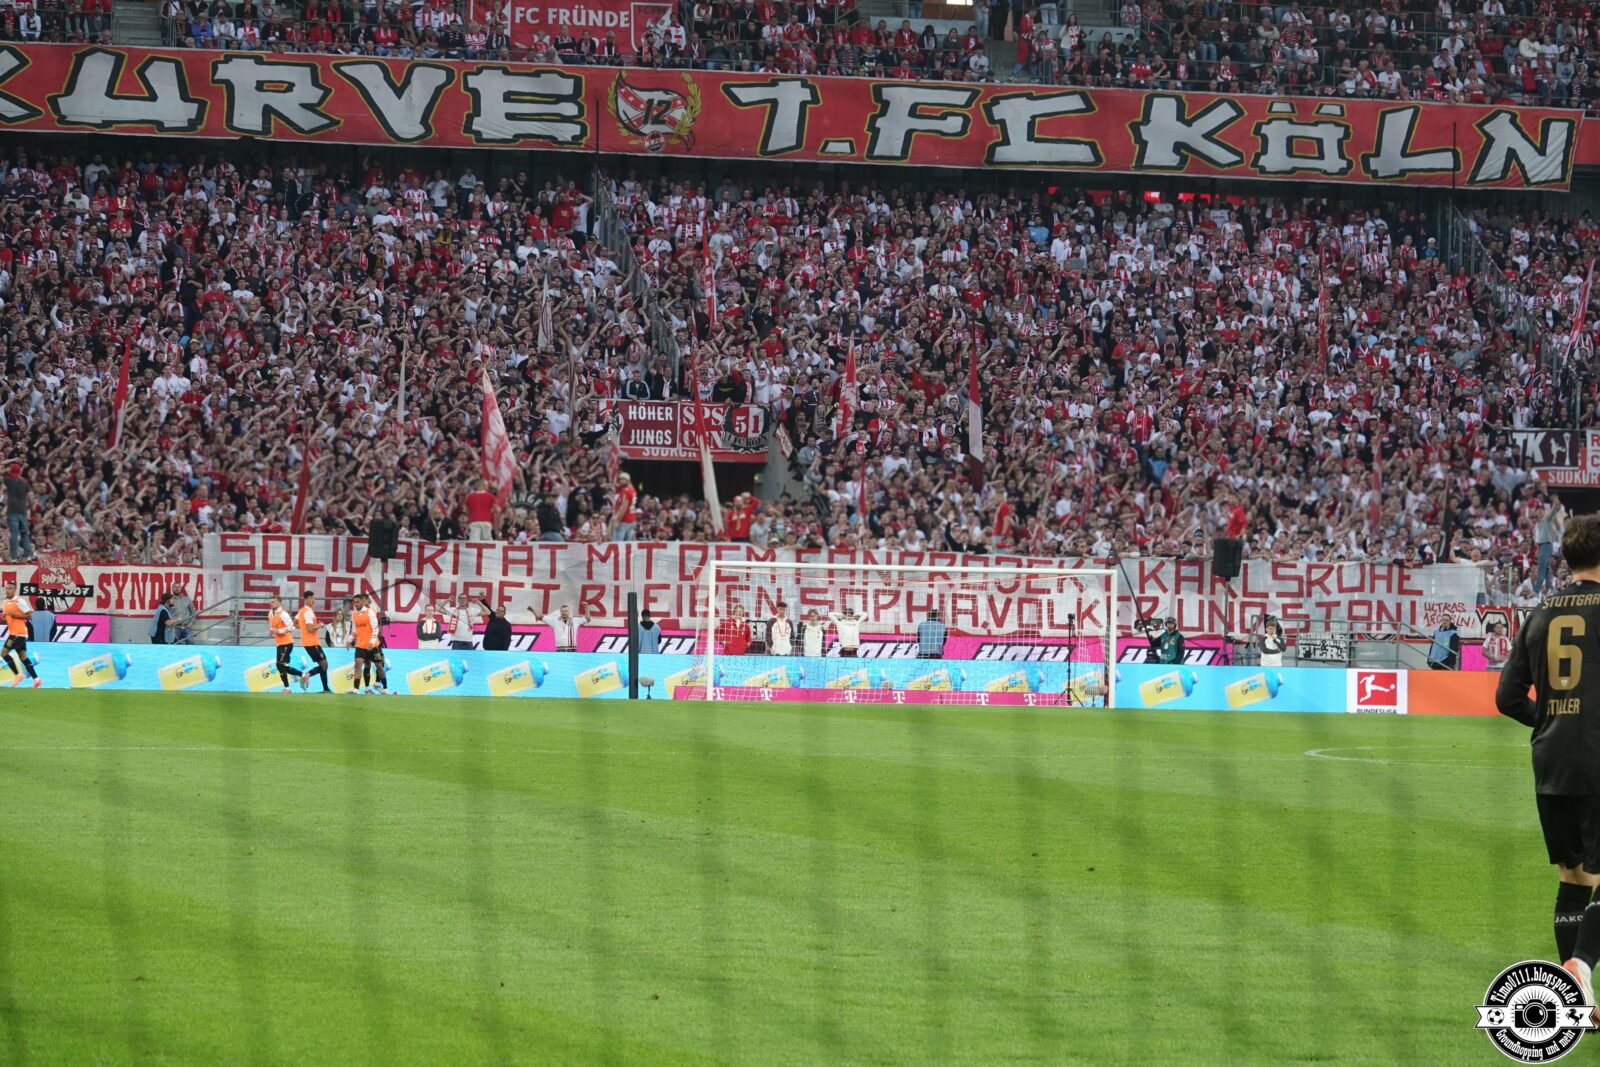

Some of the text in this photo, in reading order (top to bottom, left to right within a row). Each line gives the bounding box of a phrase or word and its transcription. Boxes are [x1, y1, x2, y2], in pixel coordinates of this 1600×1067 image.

[514, 7, 540, 24] FC
[547, 5, 630, 28] FRÜNDE
[642, 98, 672, 125] 12
[1130, 93, 1573, 186] KÖLN
[628, 401, 673, 422] HÖHER
[629, 429, 672, 445] JUNGS
[220, 533, 1423, 599] SOLIDARITÄT MIT DEM FANPROJEKT KARLSRUHE
[244, 573, 560, 615] STANDHAFT
[578, 583, 783, 619] BLEIBEN
[1177, 598, 1268, 633] UND
[1424, 602, 1466, 614] ULTRAS
[1547, 615, 1585, 690] 6
